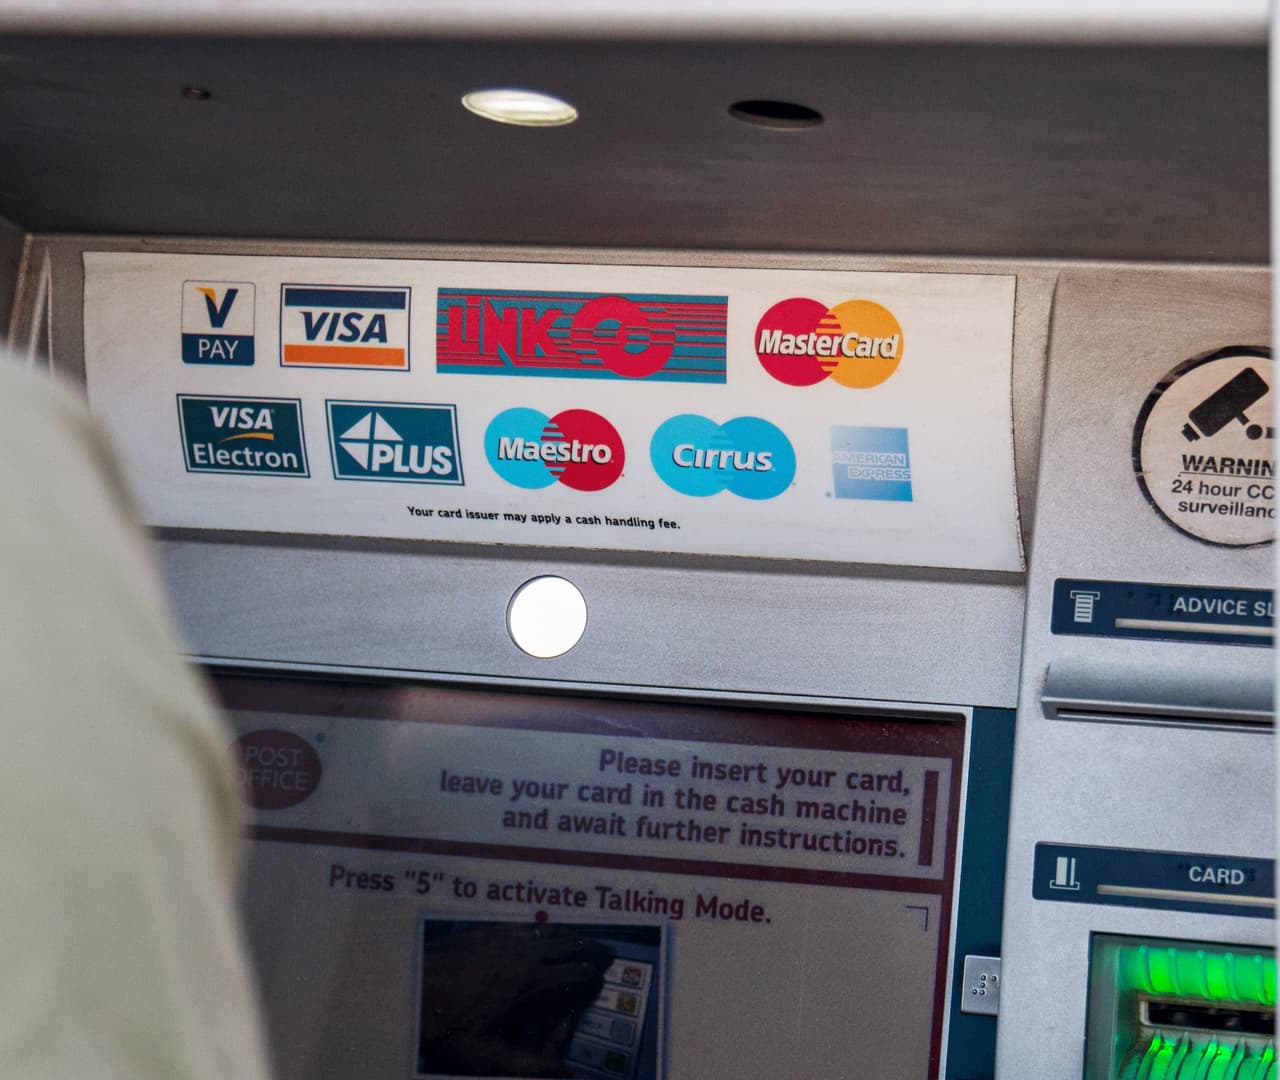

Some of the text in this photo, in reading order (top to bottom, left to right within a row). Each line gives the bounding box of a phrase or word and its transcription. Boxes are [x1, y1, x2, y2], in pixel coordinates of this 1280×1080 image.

[195, 287, 239, 329] V
[299, 311, 388, 344] VISA
[198, 339, 239, 360] PAY
[757, 328, 900, 360] MasterCard
[209, 406, 274, 430] VISA
[193, 443, 299, 469] Electron
[372, 443, 453, 475] PLUS
[497, 436, 613, 465] Maestro
[672, 443, 773, 472] Cirrus
[832, 453, 905, 465] AMERICAN
[849, 468, 911, 480] EXPRESS
[1182, 454, 1276, 477] WARNIN
[1171, 479, 1276, 500] 24 hour CC
[407, 505, 681, 530] Your card issuer may apply a cash handling fee.
[1178, 500, 1277, 519] surveillanc
[1173, 597, 1278, 617] ADVICE SL
[246, 746, 303, 768] POST
[599, 749, 910, 796] Please insert your card,
[440, 769, 907, 825] leave your card in the cash machine
[503, 808, 905, 858] and await further instructions.
[1188, 866, 1245, 885] CARD
[329, 863, 771, 924] Press "5" to activate Talking Mode.
